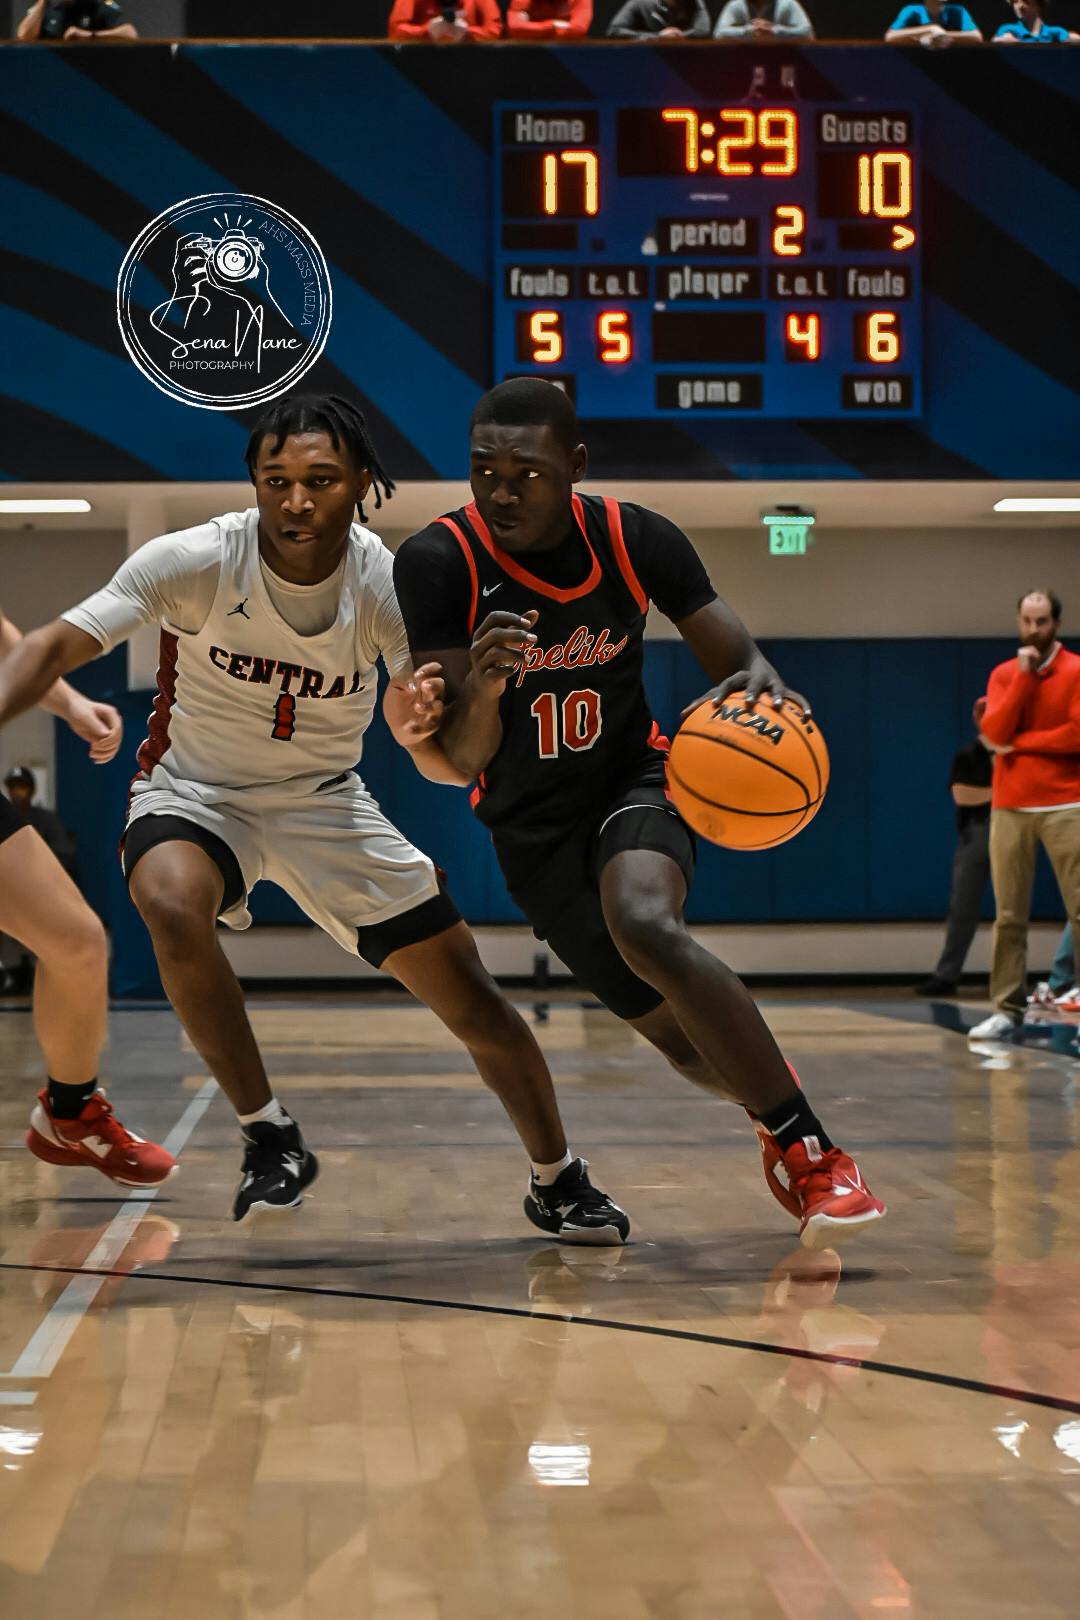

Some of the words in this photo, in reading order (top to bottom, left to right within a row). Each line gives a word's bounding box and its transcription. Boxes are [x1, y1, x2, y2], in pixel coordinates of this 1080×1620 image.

[516, 113, 584, 142] Home
[662, 108, 797, 175] 7:29
[822, 113, 907, 143] Guests
[544, 152, 599, 215] 17
[859, 153, 911, 217] 10
[670, 218, 746, 252] period
[774, 206, 803, 256] 2
[511, 267, 568, 296] fouls
[669, 265, 749, 300] player
[848, 268, 904, 297] fouls
[531, 312, 562, 362] 5
[600, 312, 631, 361] 5
[787, 313, 819, 360] 4
[868, 312, 899, 362] 6
[678, 380, 741, 409] game
[853, 381, 901, 403] won
[208, 646, 366, 699] CENTRAL
[514, 625, 629, 688] pelik
[271, 692, 296, 741] 1
[531, 688, 602, 759] 10
[712, 704, 785, 745] NCAA
